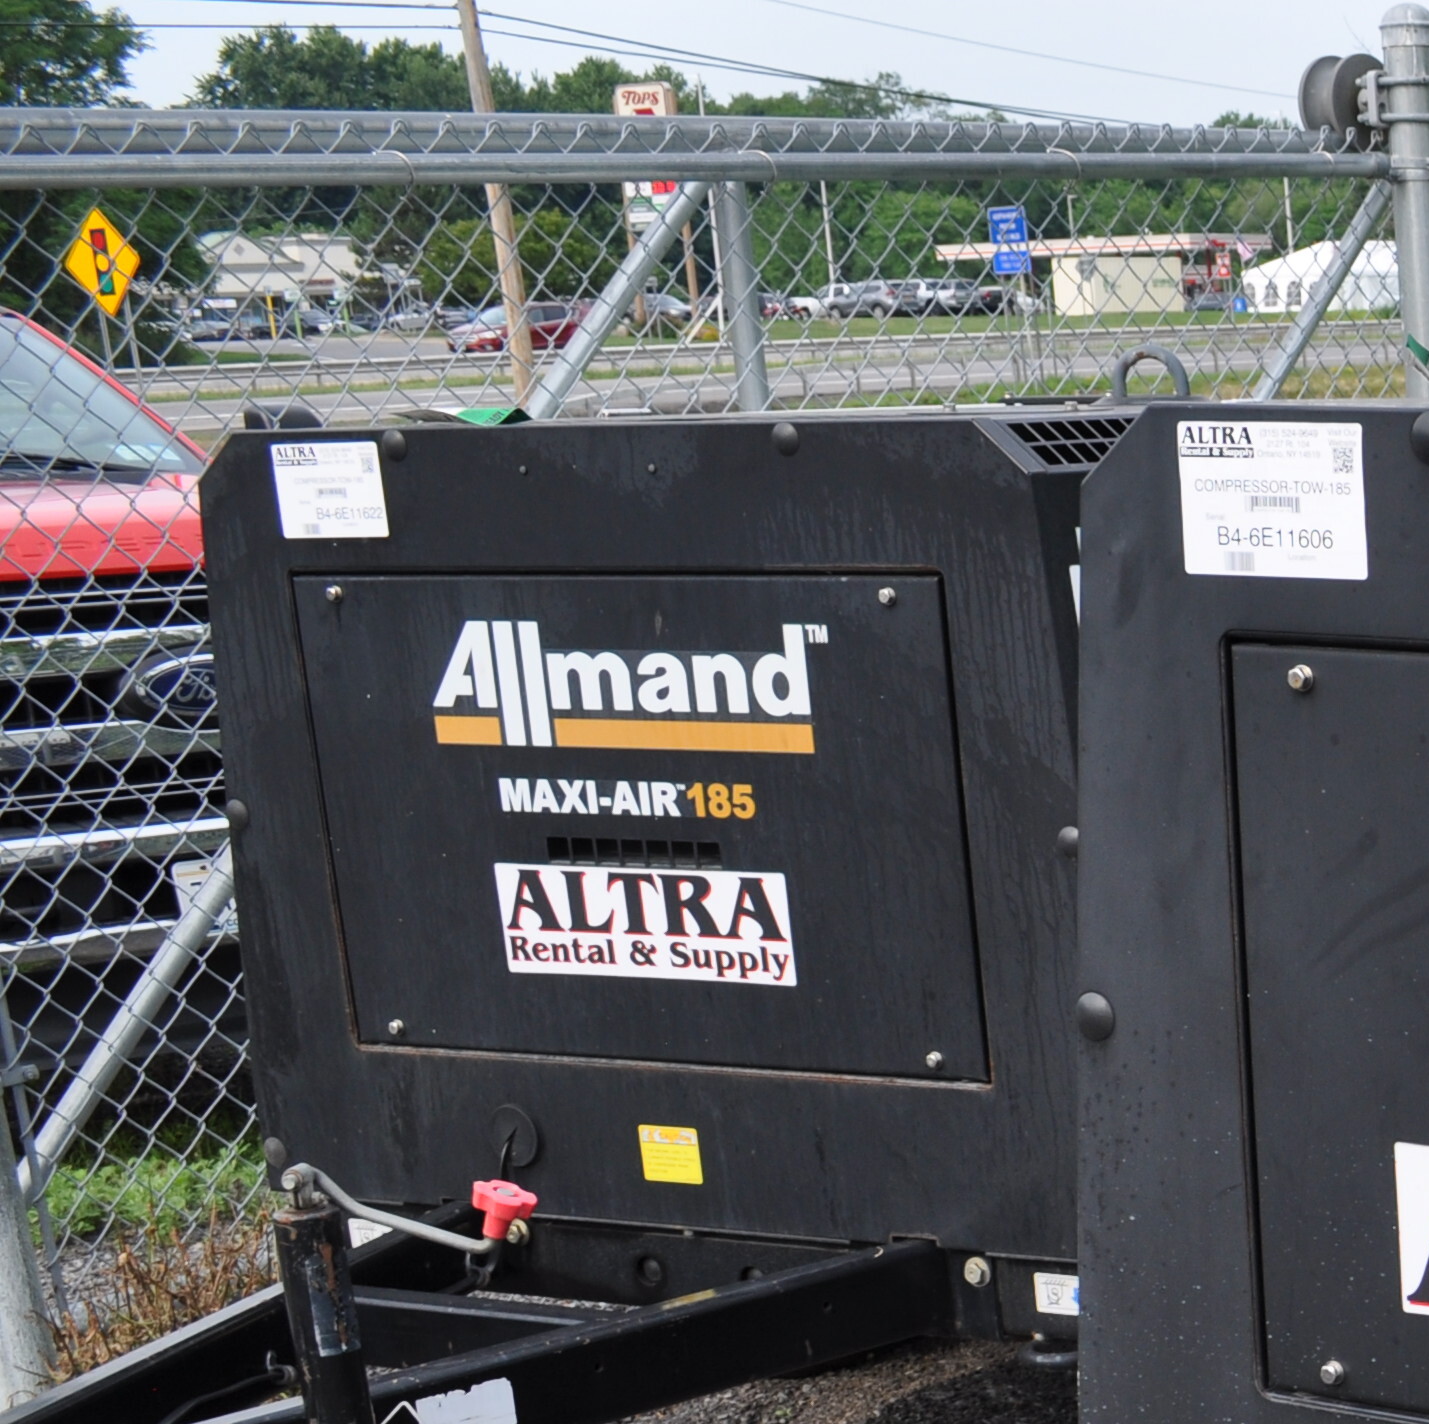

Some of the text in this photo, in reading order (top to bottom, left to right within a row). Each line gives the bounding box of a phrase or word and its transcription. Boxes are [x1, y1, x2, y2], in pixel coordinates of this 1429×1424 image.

[621, 90, 659, 106] TOPS
[1182, 426, 1252, 444] ALTRA
[276, 446, 316, 458] ALTRA
[1195, 479, 1351, 495] COMPRESSOR-TOW-185
[316, 507, 384, 520] B4-6E11622
[1217, 526, 1334, 549] B4-6E11606
[433, 620, 812, 747] Allmand
[498, 777, 682, 817] MAXI-AIR
[686, 782, 757, 820] 185
[507, 869, 788, 943] ALTRA
[509, 935, 789, 981] Rental & Supply
